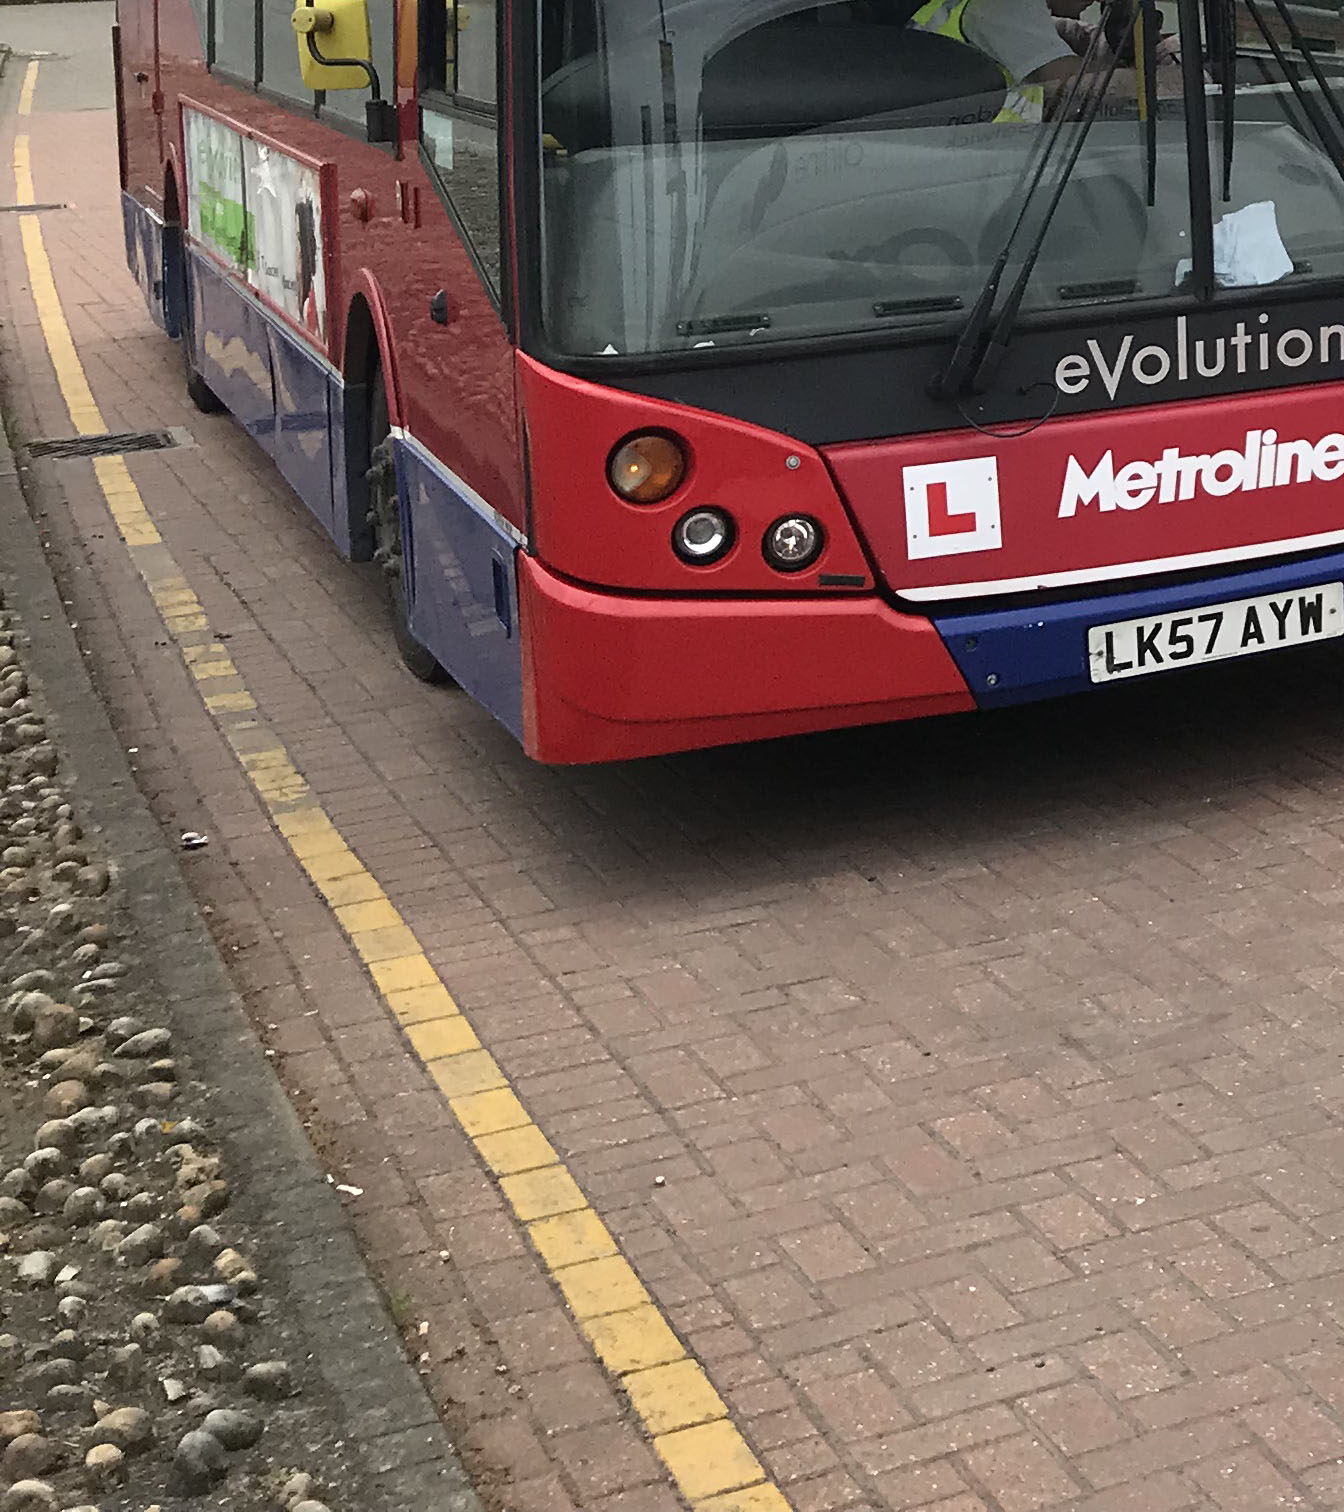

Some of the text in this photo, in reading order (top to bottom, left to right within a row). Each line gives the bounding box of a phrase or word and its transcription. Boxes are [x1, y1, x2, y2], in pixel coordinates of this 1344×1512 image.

[926, 481, 977, 538] L
[1104, 593, 1324, 675] LK57 AYW
